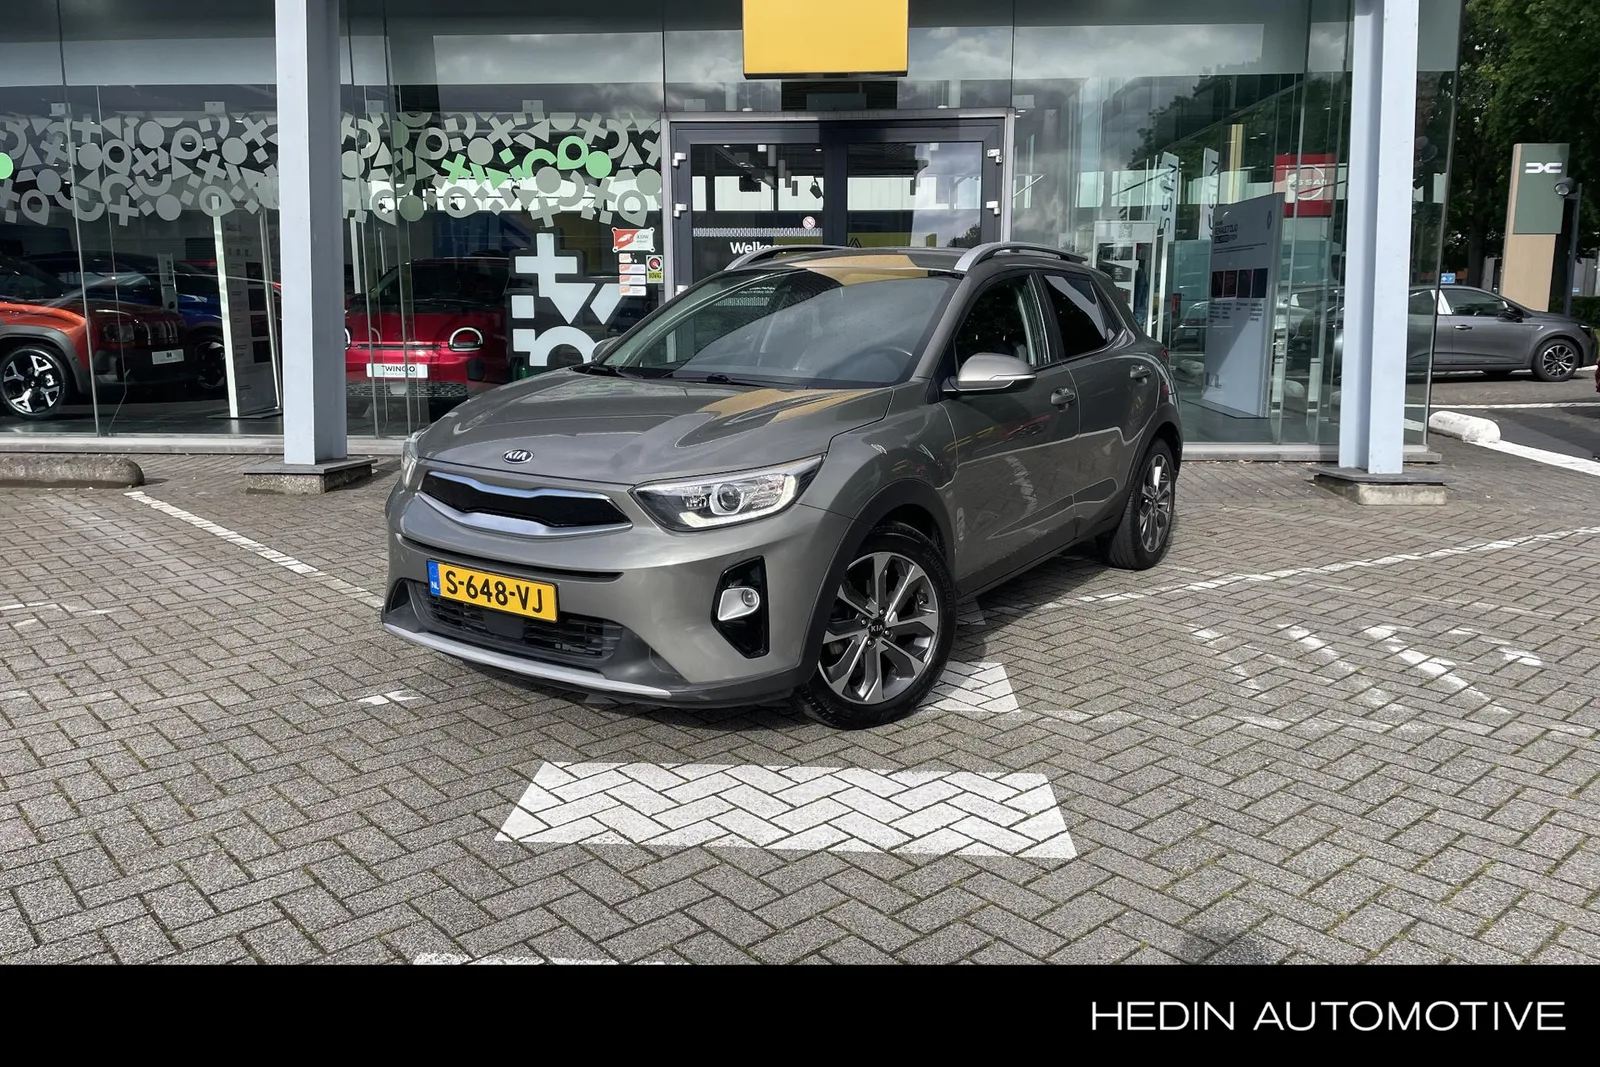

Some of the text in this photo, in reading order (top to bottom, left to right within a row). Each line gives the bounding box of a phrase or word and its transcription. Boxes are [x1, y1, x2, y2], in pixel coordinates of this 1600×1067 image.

[729, 241, 787, 254] Welk
[504, 450, 528, 461] KIA
[445, 570, 543, 614] S-648-VJ
[870, 624, 884, 632] KIA
